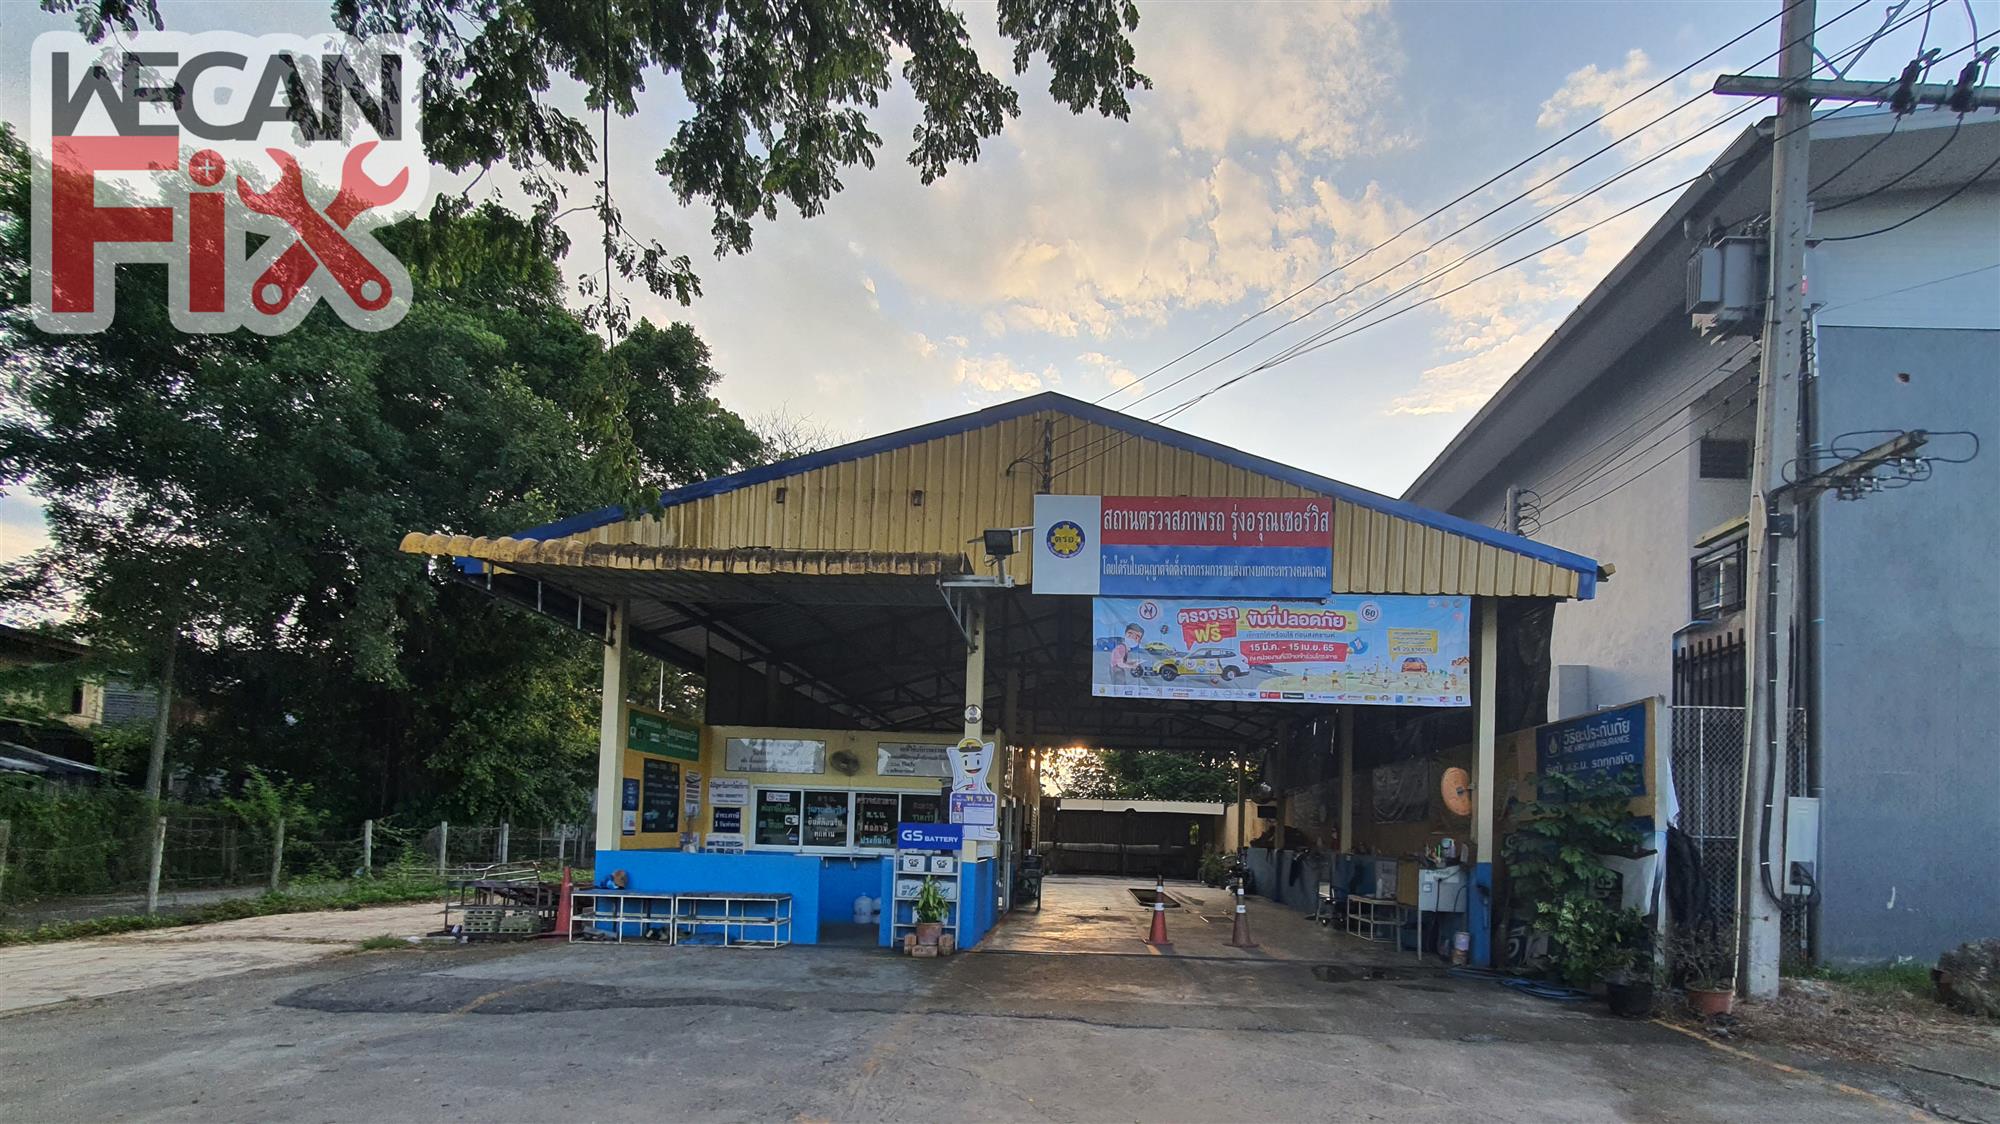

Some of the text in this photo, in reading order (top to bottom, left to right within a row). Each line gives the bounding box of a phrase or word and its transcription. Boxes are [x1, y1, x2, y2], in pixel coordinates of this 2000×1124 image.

[1103, 503, 1329, 541] สถานตรวจสภาพรถ รุ่งอรุณเซอร์วิส
[1178, 605, 1345, 628] ตรวจรถ ขับขี่ปลอดภัย
[1365, 608, 1375, 617] 60
[1194, 623, 1222, 643] ฟรี
[1262, 643, 1280, 651] มี.ค.
[1289, 643, 1299, 651] 15
[1563, 718, 1630, 745] วิริยะประกันภัย
[902, 829, 959, 844] GS BATTERY
